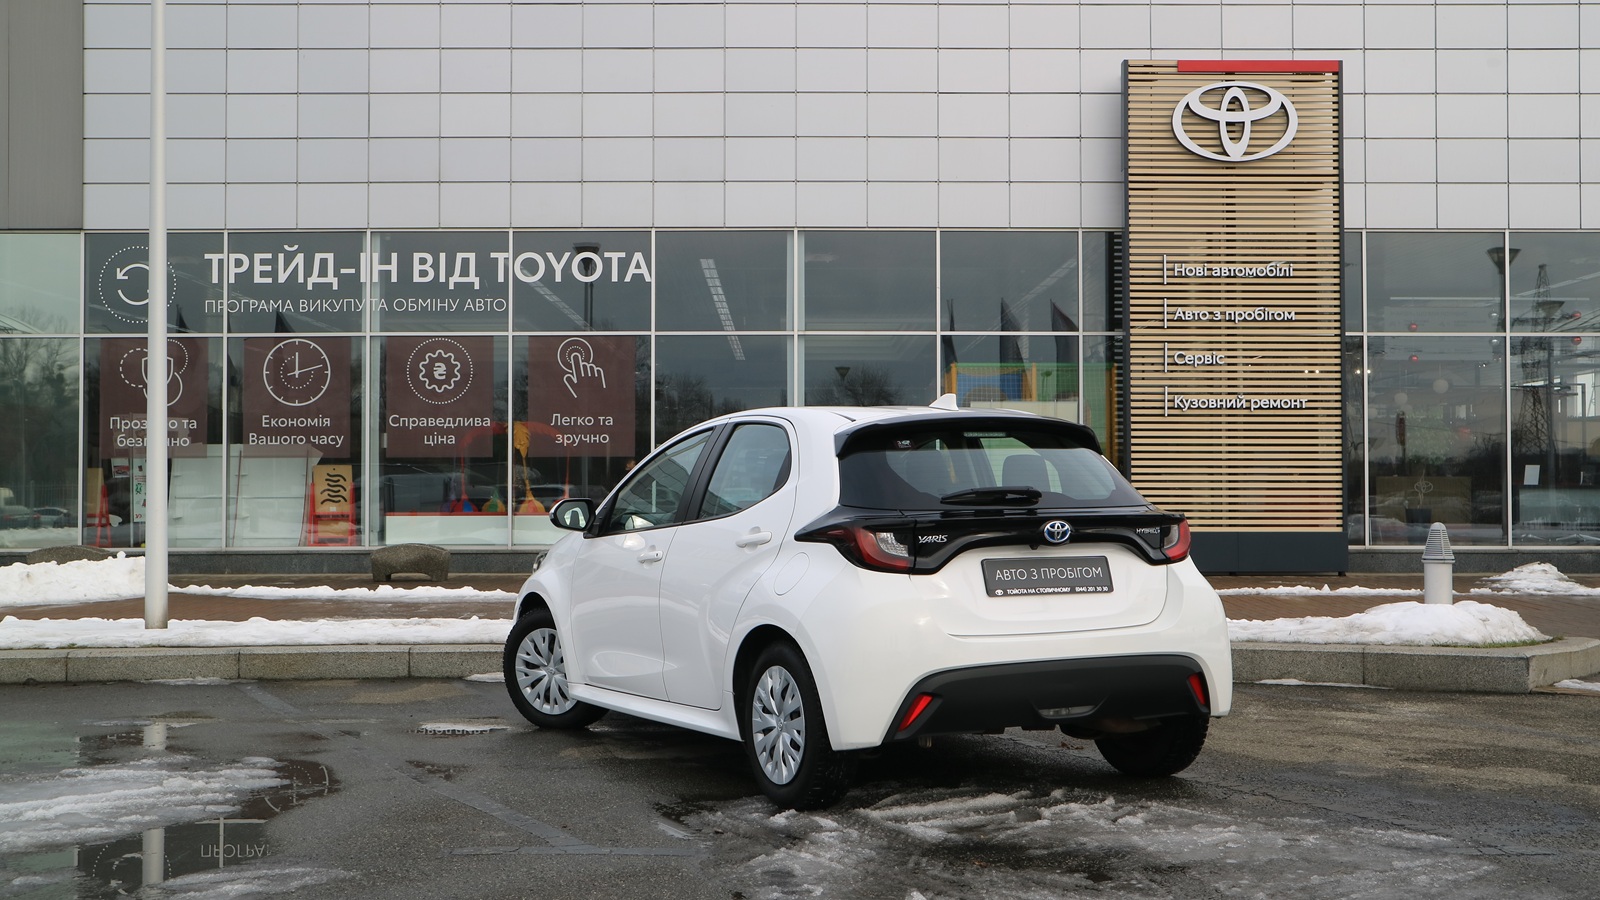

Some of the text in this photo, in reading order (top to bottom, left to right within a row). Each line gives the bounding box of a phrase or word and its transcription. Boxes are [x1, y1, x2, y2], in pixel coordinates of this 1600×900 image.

[204, 244, 652, 290] ТРЕЙД-ІН ВІД TOYOTA
[1173, 263, 1294, 278] Нові автомобілі
[204, 298, 507, 313] ПРОГРАМА ВИКУПУ ТА ОБМІНУ АВТО
[1173, 307, 1296, 324] Авто з пробігом
[1173, 351, 1225, 367] Сервіс
[1173, 394, 1308, 412] Кузовний ремонт
[109, 416, 198, 432] Прозо та
[261, 415, 331, 428] Економія
[388, 414, 491, 429] Справедлива
[550, 413, 614, 426] Легко та
[116, 433, 190, 447] безно
[249, 432, 345, 448] Вашого часу
[423, 432, 456, 446] ціна
[555, 433, 610, 447] зручно
[918, 534, 948, 544] YARIS
[995, 568, 1028, 581] АВТО
[1041, 566, 1103, 580] ПРОБІГОМ
